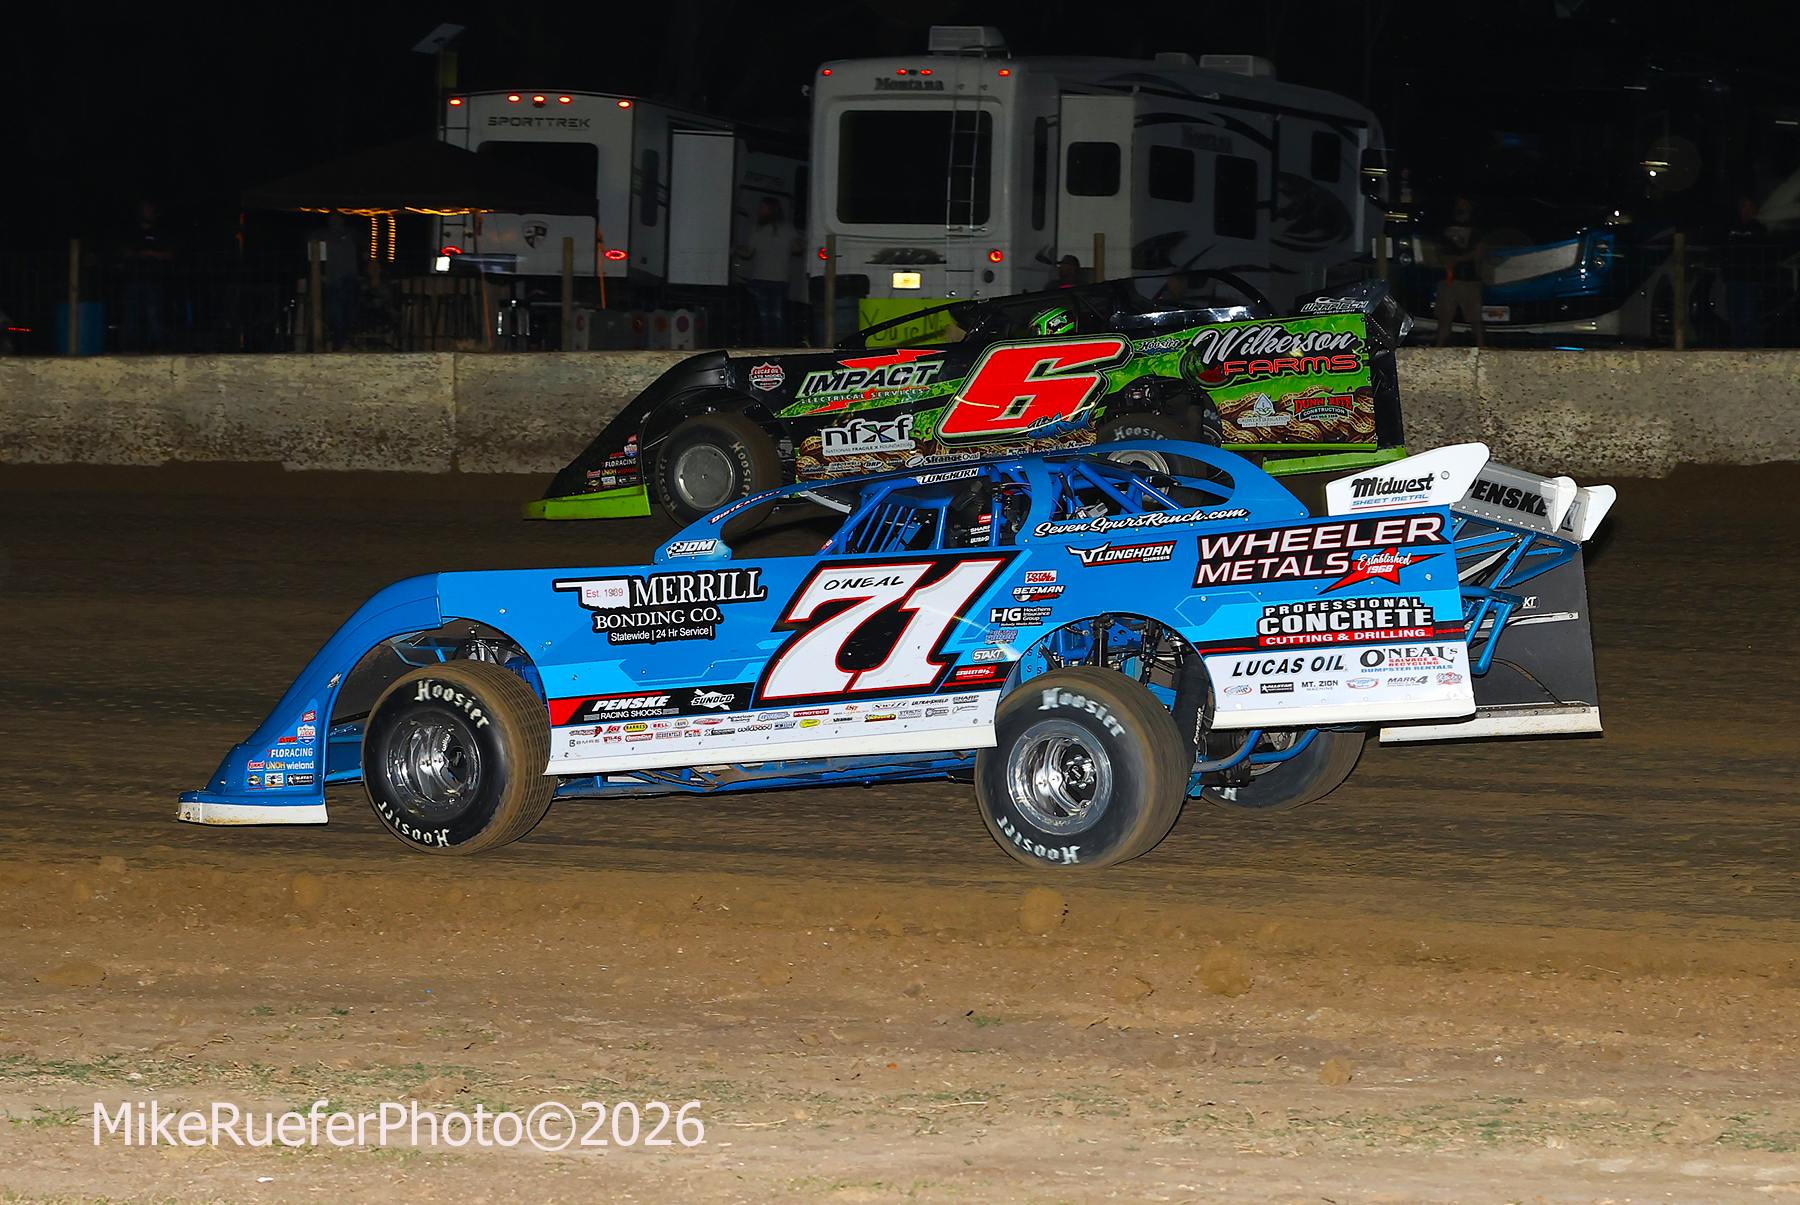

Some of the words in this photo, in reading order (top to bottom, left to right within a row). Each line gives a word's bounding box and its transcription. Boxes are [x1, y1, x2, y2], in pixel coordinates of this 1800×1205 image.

[874, 77, 945, 92] Montana
[487, 116, 592, 128] SPORTTREK
[1192, 326, 1357, 365] Wilkerson
[1223, 354, 1357, 376] FARMS
[802, 364, 941, 393] IMPACT
[941, 338, 1125, 436] 6
[802, 394, 865, 404] ELECTRICAL
[871, 388, 925, 399] SERVICES
[1295, 397, 1325, 412] DUNN
[1303, 408, 1345, 416] CONSTRUCTION
[1113, 426, 1168, 441] Hoosie
[1351, 472, 1434, 498] Midwest
[1353, 497, 1386, 506] SHEET
[1391, 494, 1429, 502] METAL
[1470, 479, 1548, 517] ENSKE
[1034, 508, 1247, 537] SevenSpursRanch.com
[1201, 517, 1443, 560] WHEELER
[1097, 544, 1173, 562] LONGHORN
[1357, 552, 1412, 570] Established
[1197, 552, 1350, 585] METALS
[633, 570, 765, 607] MERRILL
[824, 575, 905, 590] O'NEAL
[1013, 585, 1064, 595] BEEMAN
[991, 608, 1022, 622] HG
[1265, 597, 1425, 616] PROFESSIONAL
[595, 609, 685, 630] BONDING
[690, 607, 722, 622] CO.
[1260, 608, 1433, 635] CONCRETE
[611, 630, 650, 642] Statewide
[656, 629, 667, 638] 24
[668, 628, 678, 637] Hr
[680, 626, 709, 637] Service
[762, 559, 1003, 698] 71
[1266, 633, 1332, 645] CUTTING
[1337, 632, 1346, 641] &
[1354, 629, 1426, 640] DRILLING
[1231, 656, 1305, 678] LUCAS
[1311, 654, 1347, 672] OIL
[1361, 665, 1411, 673] DUMPSTER
[414, 679, 490, 729] Hoosier
[592, 695, 671, 712] PENSKE
[691, 694, 735, 706] SUNOCO
[601, 710, 629, 719] RACING
[631, 708, 662, 717] SHOCKS
[1038, 686, 1126, 737] Hoosier
[271, 747, 314, 758] FLORACING
[377, 800, 451, 848] Hoosier
[996, 815, 1082, 865] Hoosier
